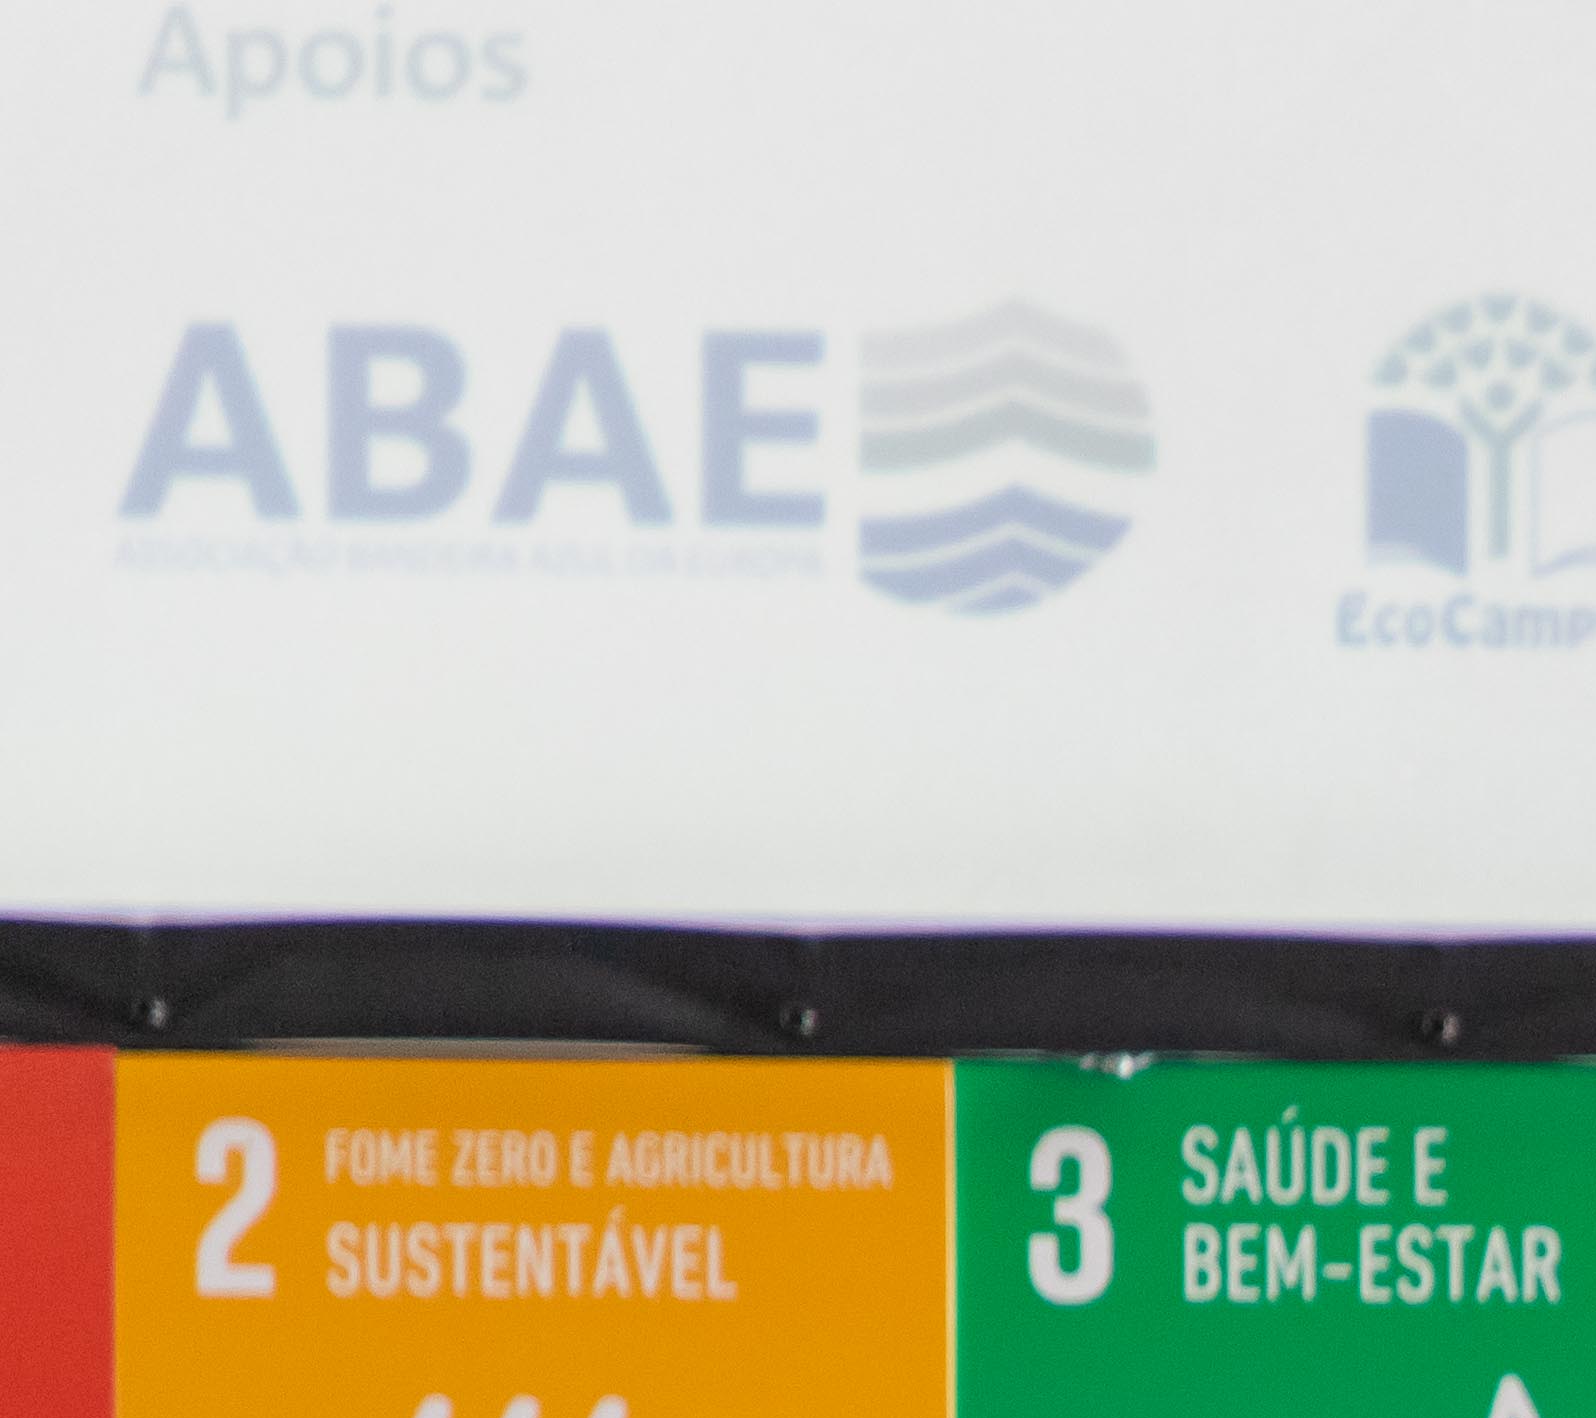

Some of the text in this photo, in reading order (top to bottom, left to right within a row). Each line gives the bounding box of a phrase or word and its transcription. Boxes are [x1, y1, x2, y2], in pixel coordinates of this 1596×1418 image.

[135, 2, 532, 121] Apoios
[117, 319, 827, 527] ABAE
[196, 1117, 277, 1298] 2
[325, 1129, 893, 1190] FOME ZERO E AGRICULTURA
[1182, 1106, 1447, 1206] SAÚDE E
[327, 1207, 737, 1300] SUSTENTÁVEL
[1028, 1126, 1114, 1305] 3
[1184, 1223, 1561, 1304] BEM-ESTAR
